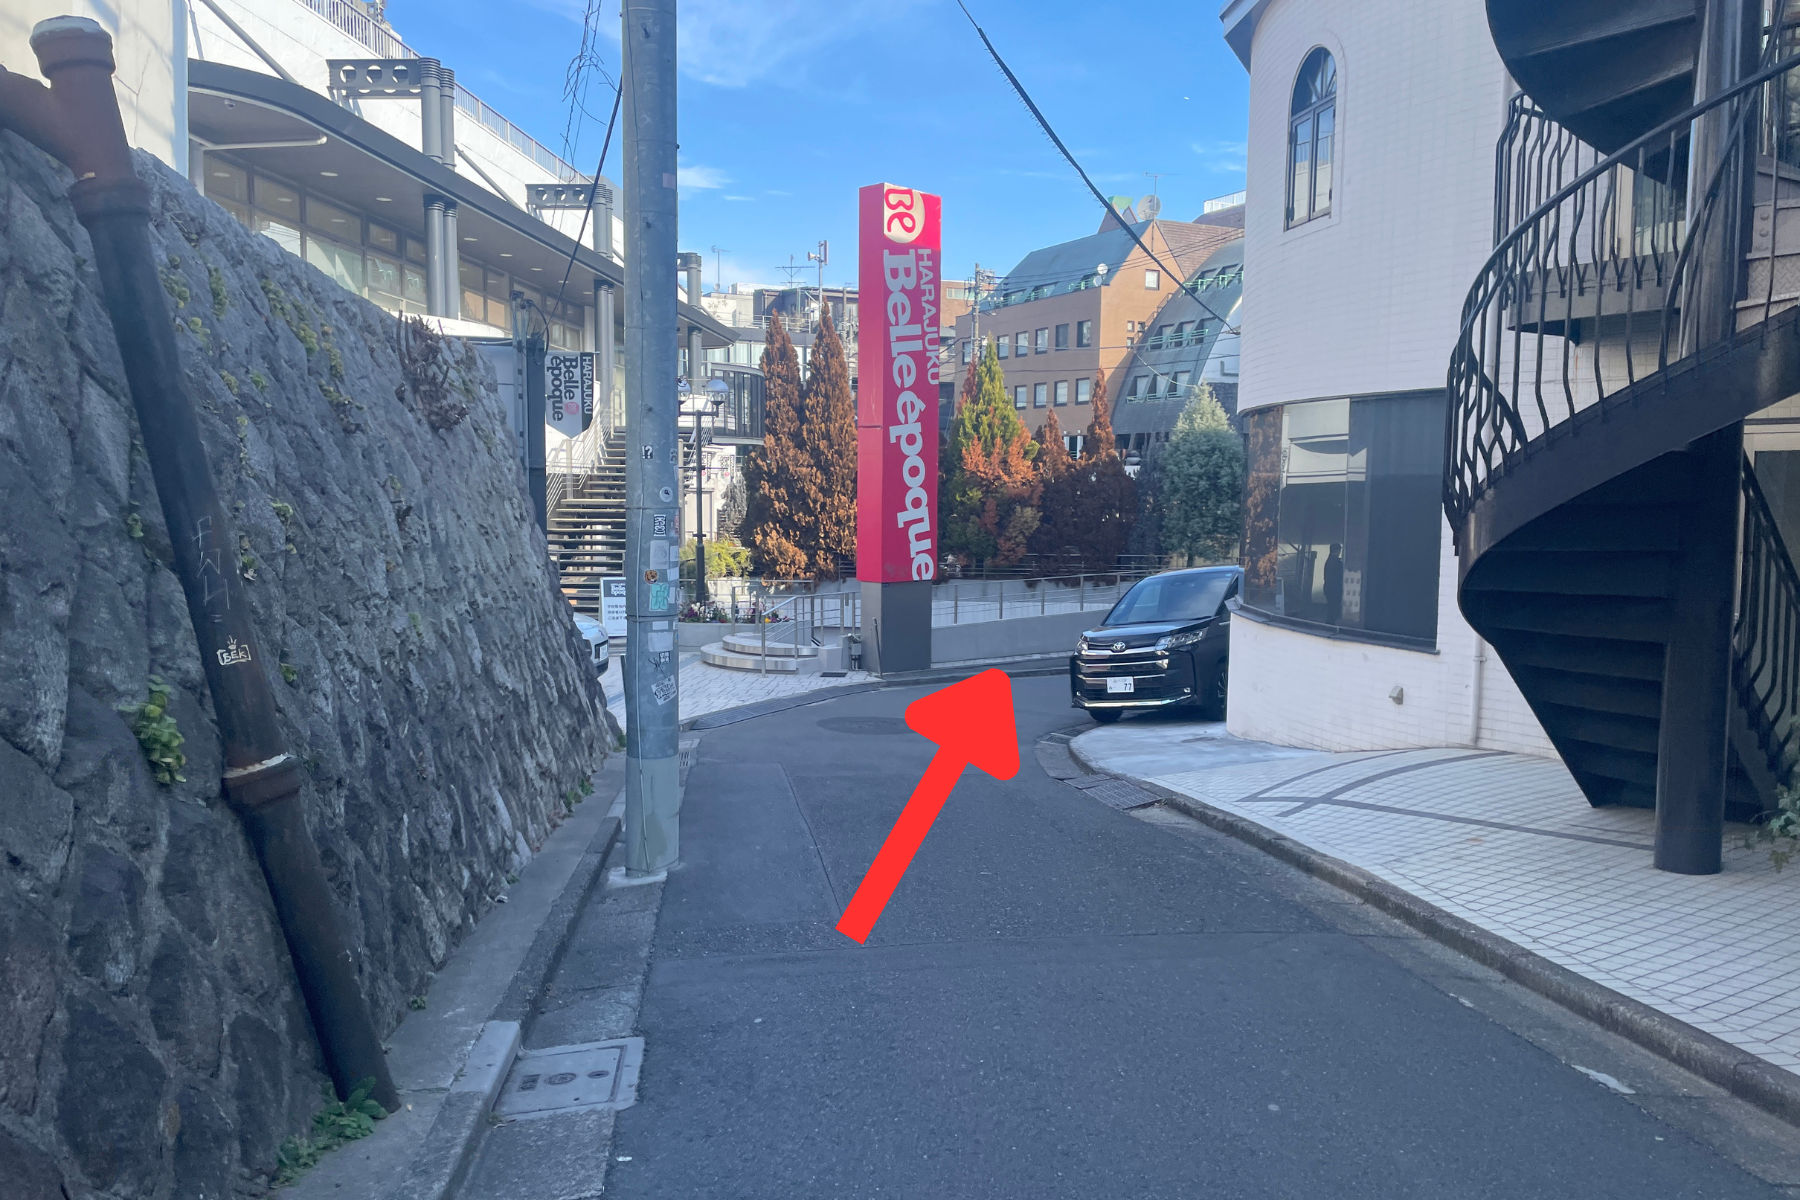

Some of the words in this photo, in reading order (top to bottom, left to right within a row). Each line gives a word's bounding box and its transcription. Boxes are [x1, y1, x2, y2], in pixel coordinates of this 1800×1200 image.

[918, 248, 940, 385] HARAJUKU
[546, 355, 564, 422] époque
[562, 356, 580, 401] Belle
[582, 356, 592, 415] HARAJUKU
